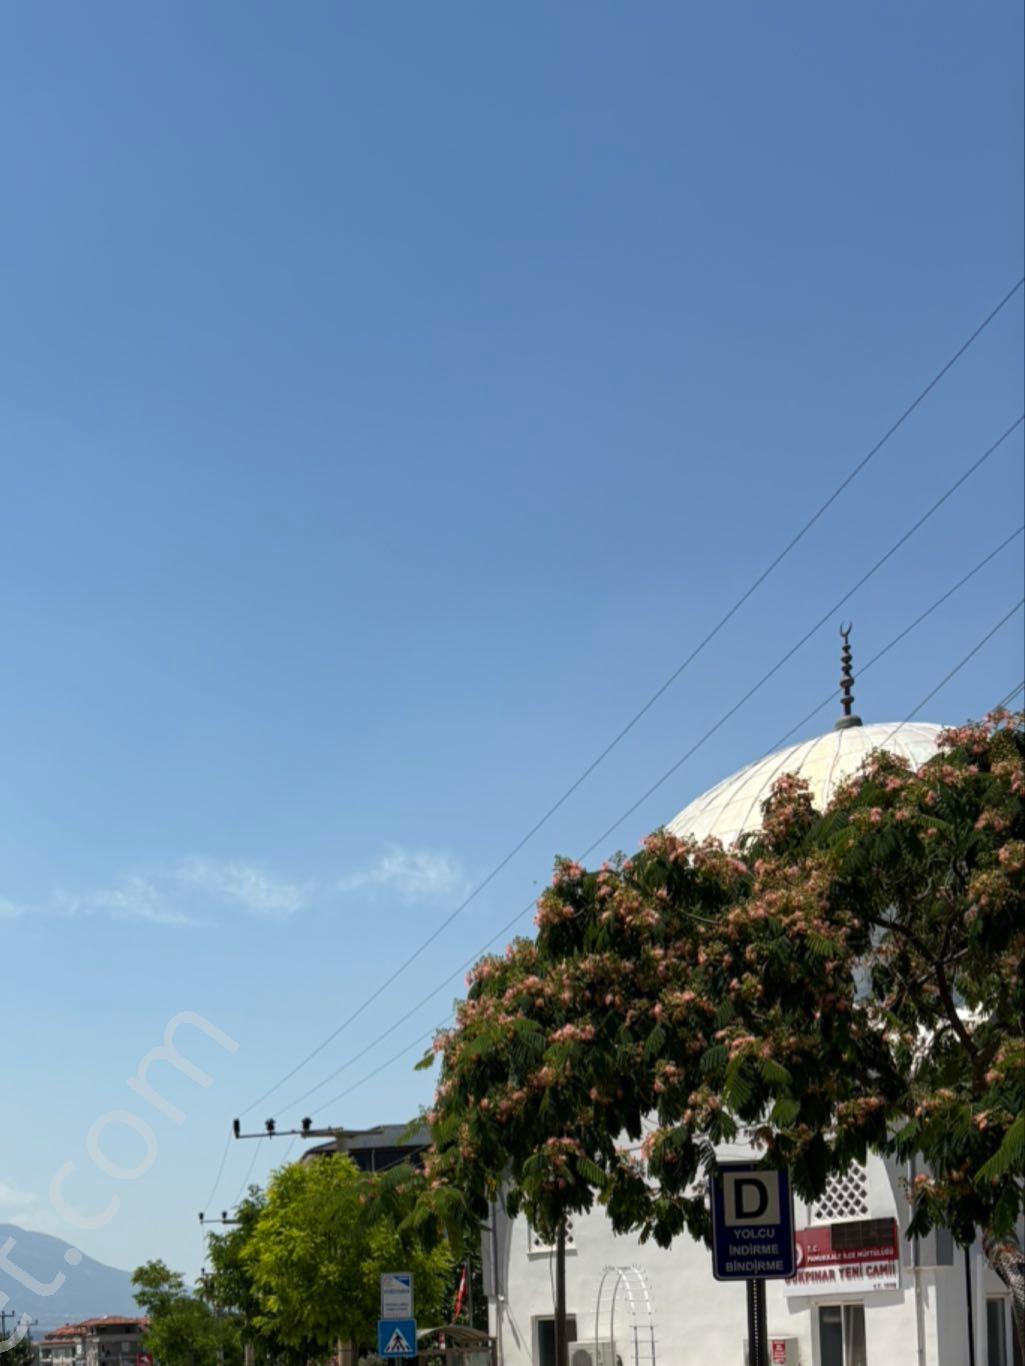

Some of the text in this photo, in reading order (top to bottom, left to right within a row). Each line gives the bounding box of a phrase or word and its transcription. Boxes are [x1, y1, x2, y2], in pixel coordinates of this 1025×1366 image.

[733, 1178, 768, 1220] D
[733, 1227, 776, 1240] YOLCU
[728, 1242, 779, 1256] İNDİRME
[725, 1259, 784, 1274] BİNDİRME
